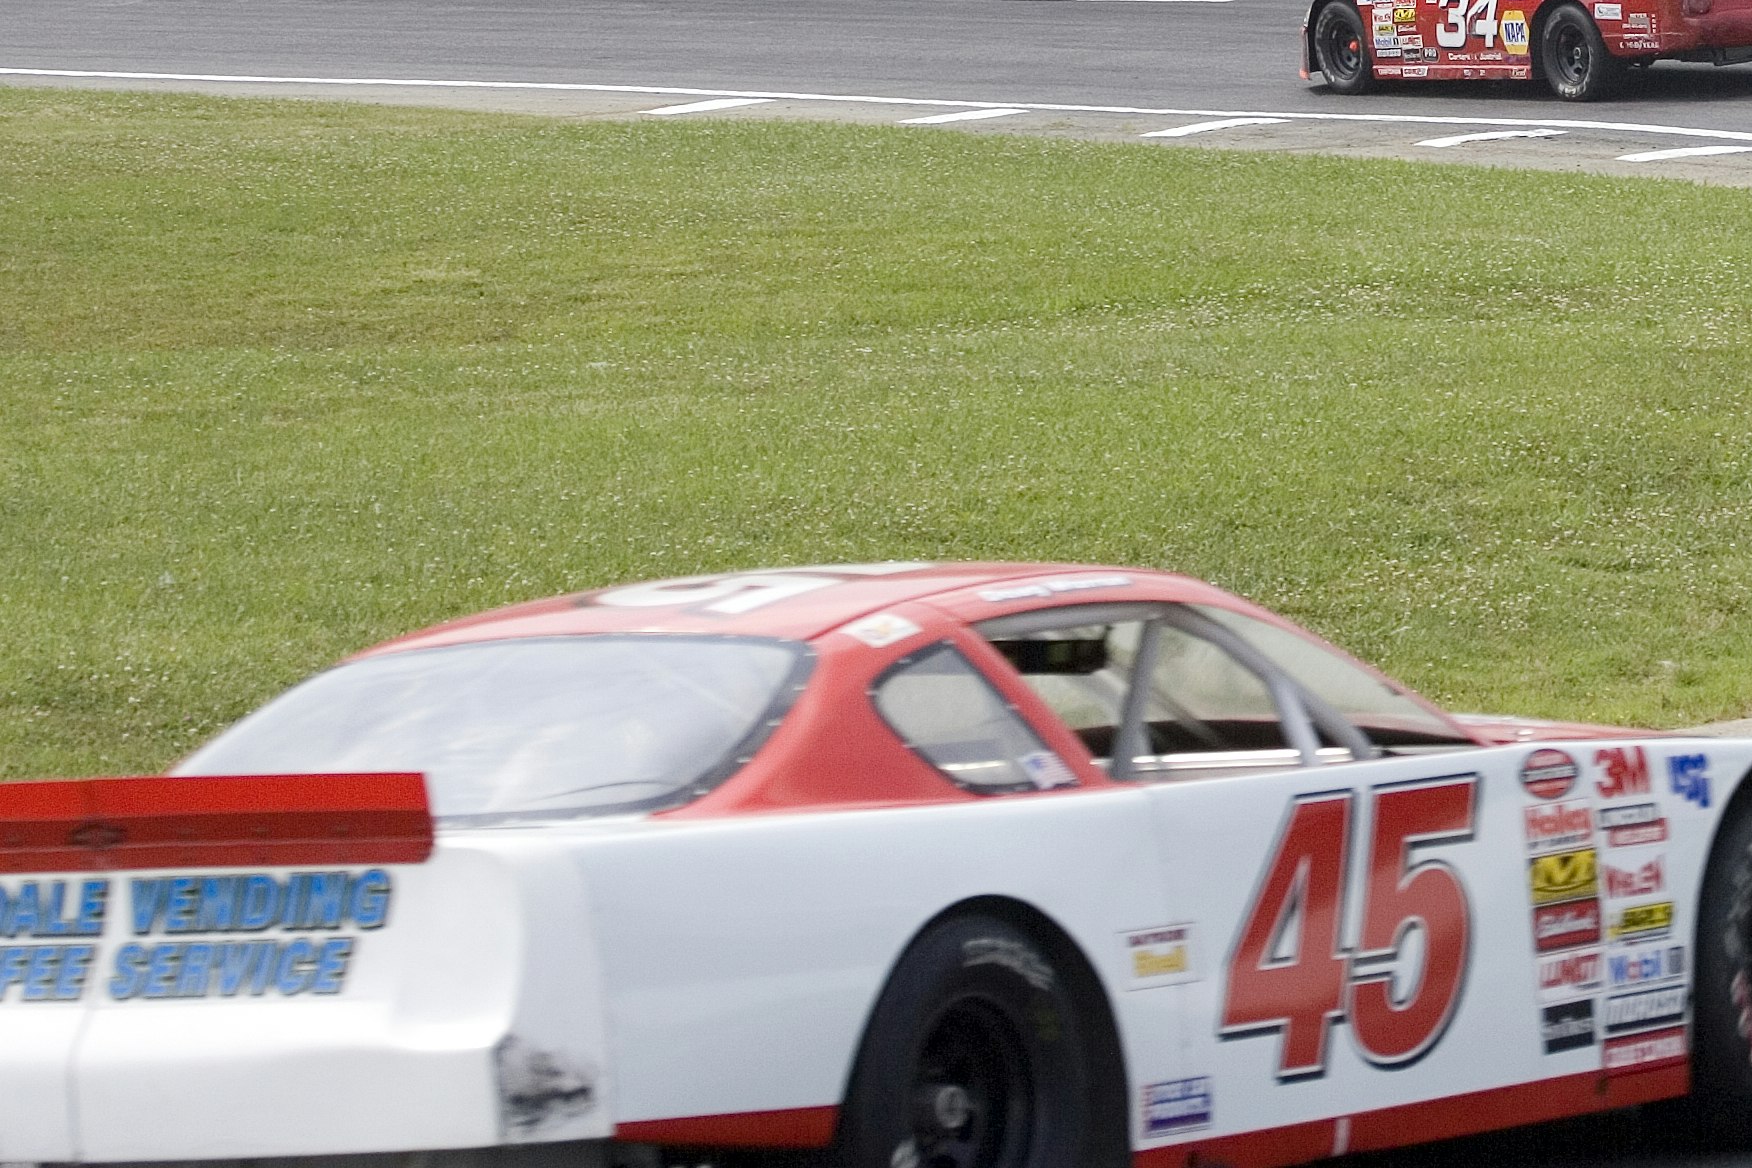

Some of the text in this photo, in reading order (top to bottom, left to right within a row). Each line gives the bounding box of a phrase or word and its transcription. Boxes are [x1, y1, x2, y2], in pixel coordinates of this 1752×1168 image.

[1505, 23, 1526, 43] NAPA
[1595, 746, 1650, 798] 3M
[128, 869, 394, 934] VENDING
[1219, 770, 1481, 1085] 45
[108, 935, 358, 1000] SERVICE
